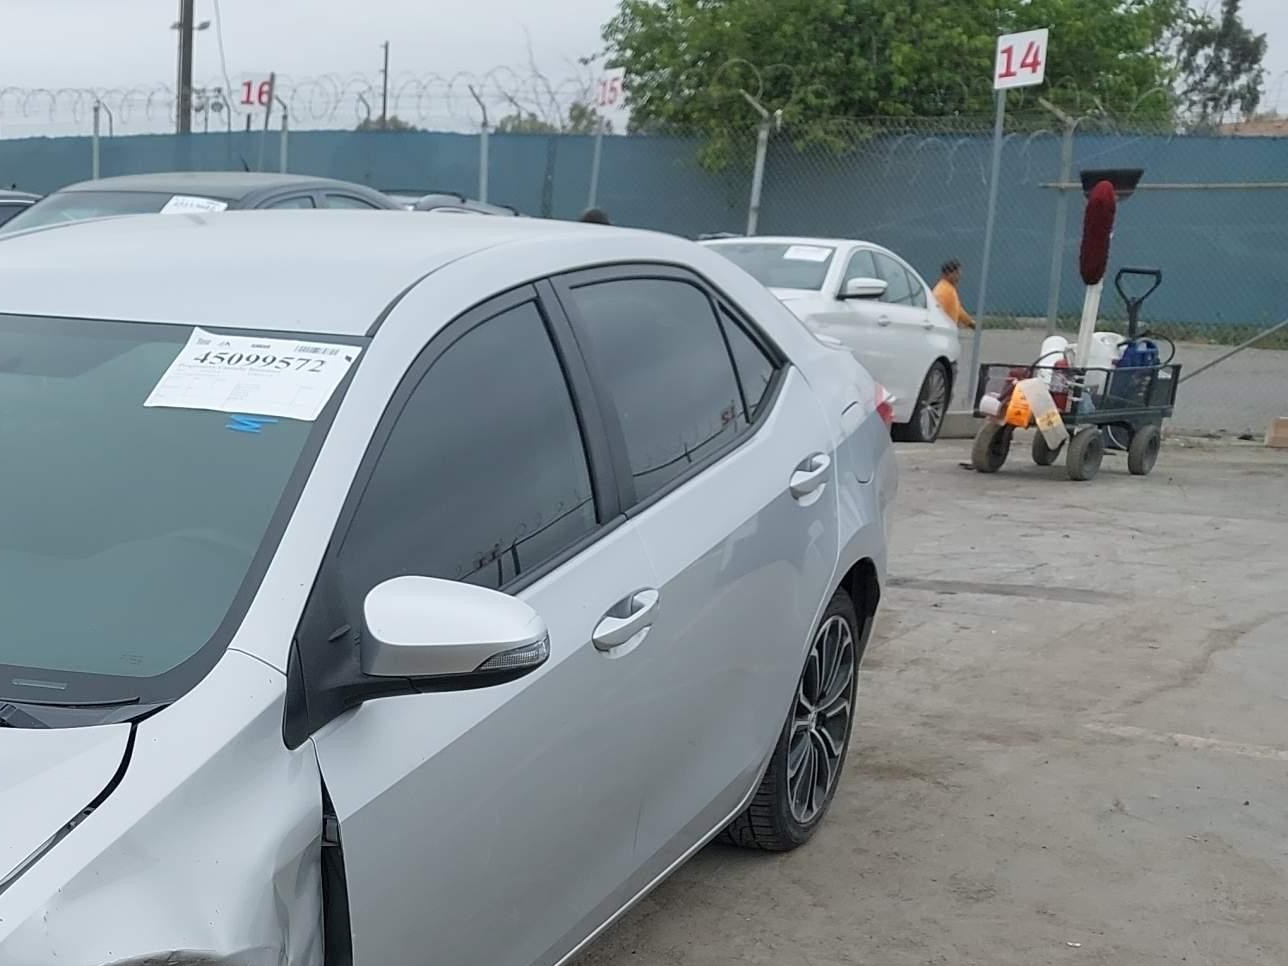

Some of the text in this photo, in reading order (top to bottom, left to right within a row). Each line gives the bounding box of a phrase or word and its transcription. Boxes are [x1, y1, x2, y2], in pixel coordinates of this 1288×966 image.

[998, 41, 1041, 78] 14
[241, 81, 272, 107] 16
[600, 77, 618, 106] 15
[193, 350, 327, 373] 45099572
